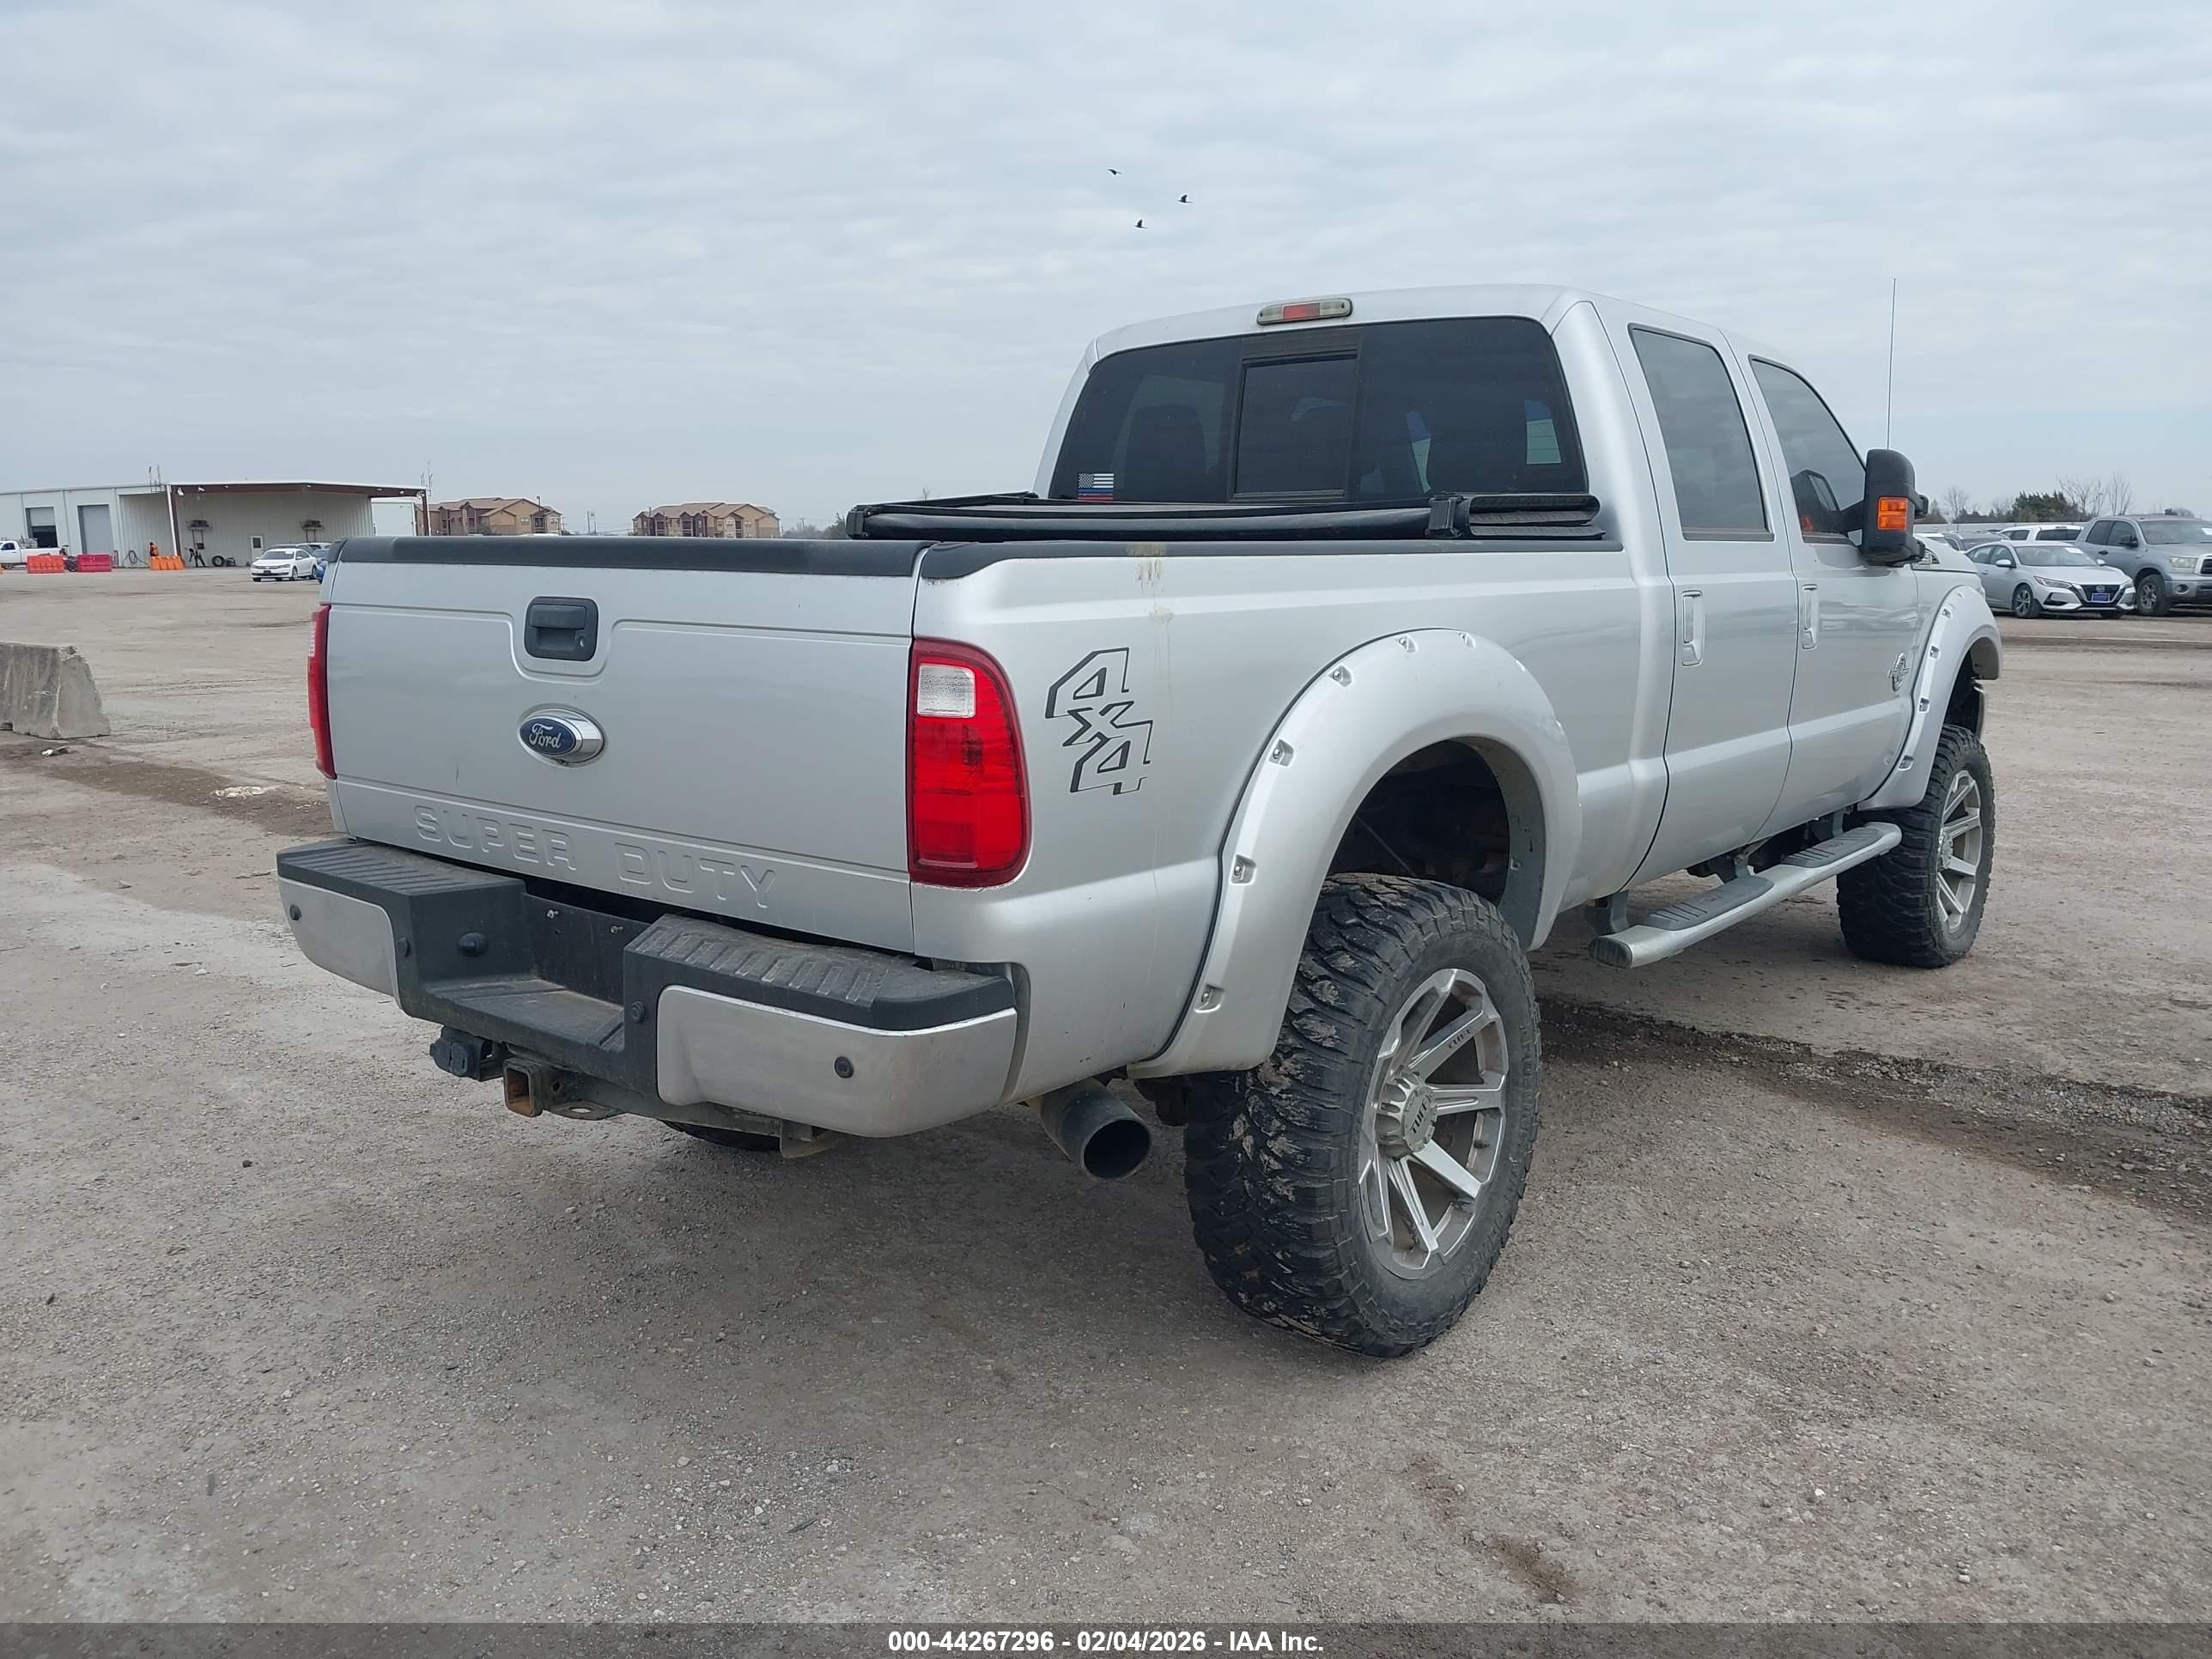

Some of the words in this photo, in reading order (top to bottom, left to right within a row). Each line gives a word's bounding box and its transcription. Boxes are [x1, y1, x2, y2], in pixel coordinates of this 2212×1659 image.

[529, 723, 562, 749] Ford
[414, 805, 577, 871] SUPER
[613, 842, 776, 908] DUTY
[1409, 1098, 1427, 1134] TUFF
